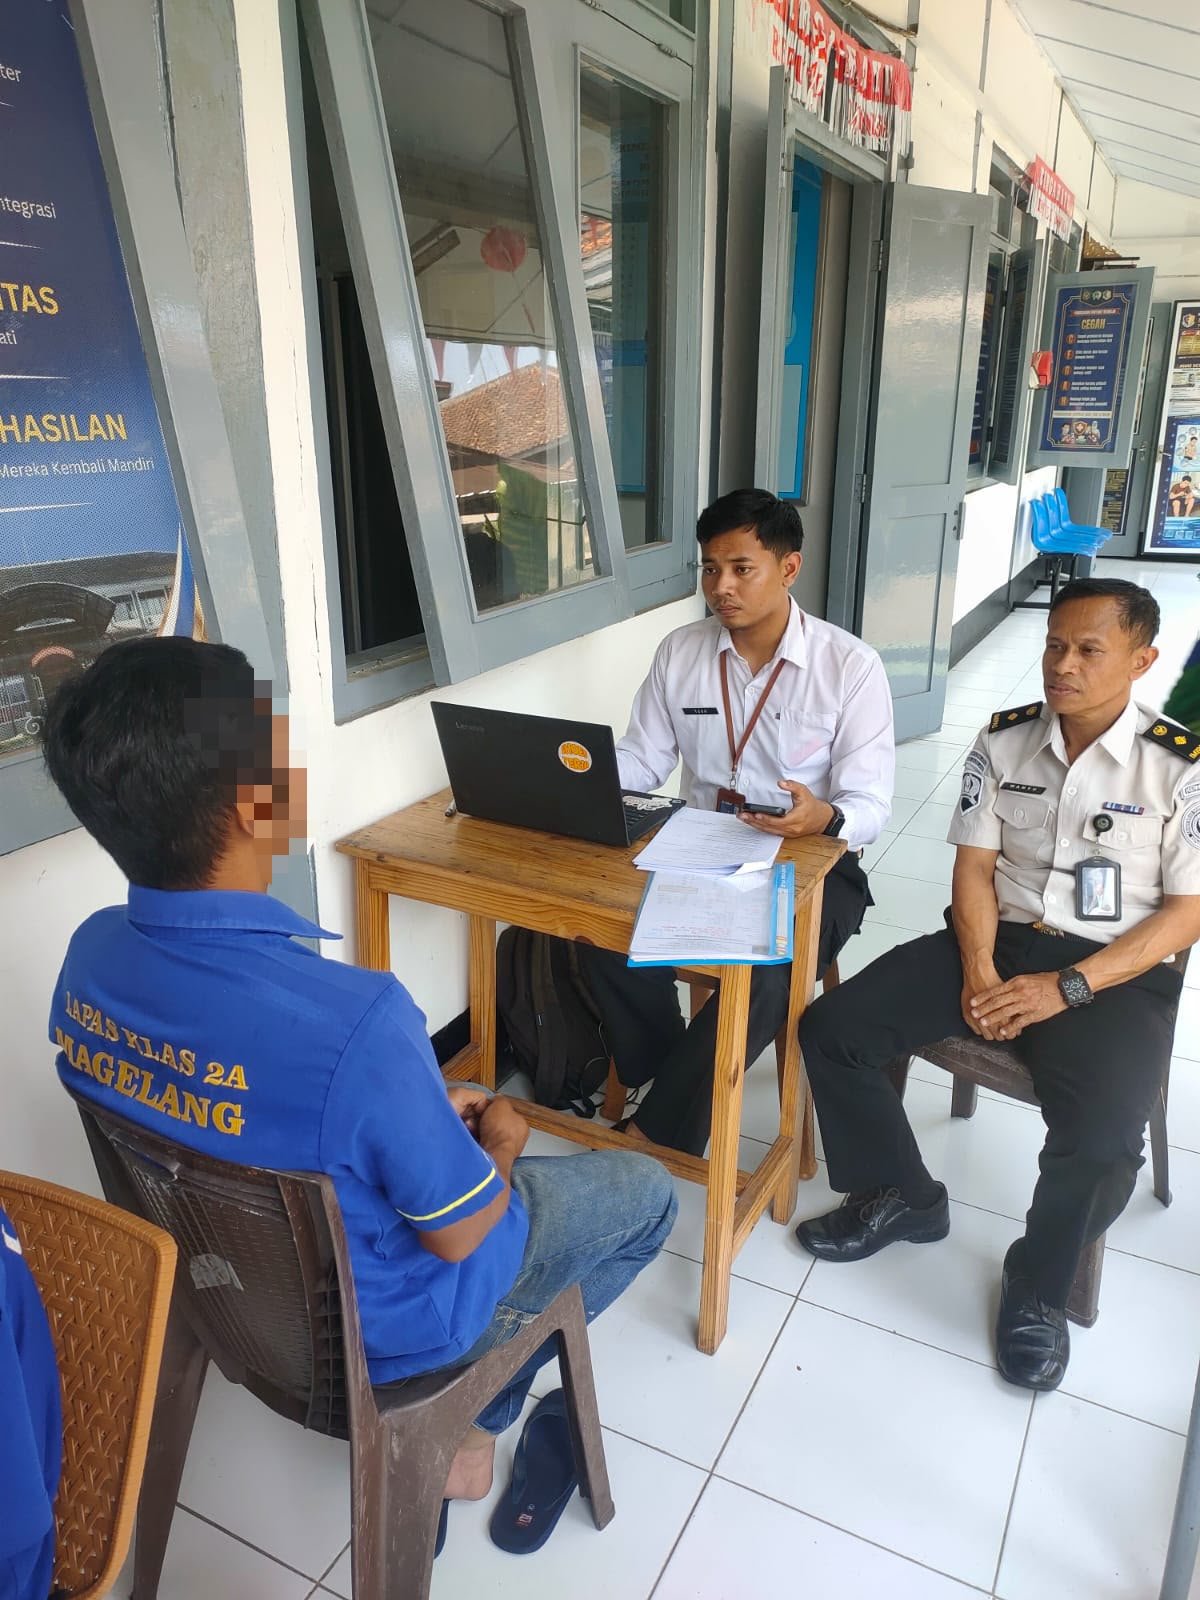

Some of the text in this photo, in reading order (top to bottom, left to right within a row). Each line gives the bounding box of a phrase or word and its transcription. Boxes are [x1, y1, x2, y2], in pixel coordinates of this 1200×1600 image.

[0, 413, 128, 443] HASILAN
[52, 458, 106, 475] Kembali
[107, 456, 155, 472] Mandiri
[65, 991, 249, 1090] LAPAS KLAS 2A
[55, 1026, 246, 1136] MAGELANG
